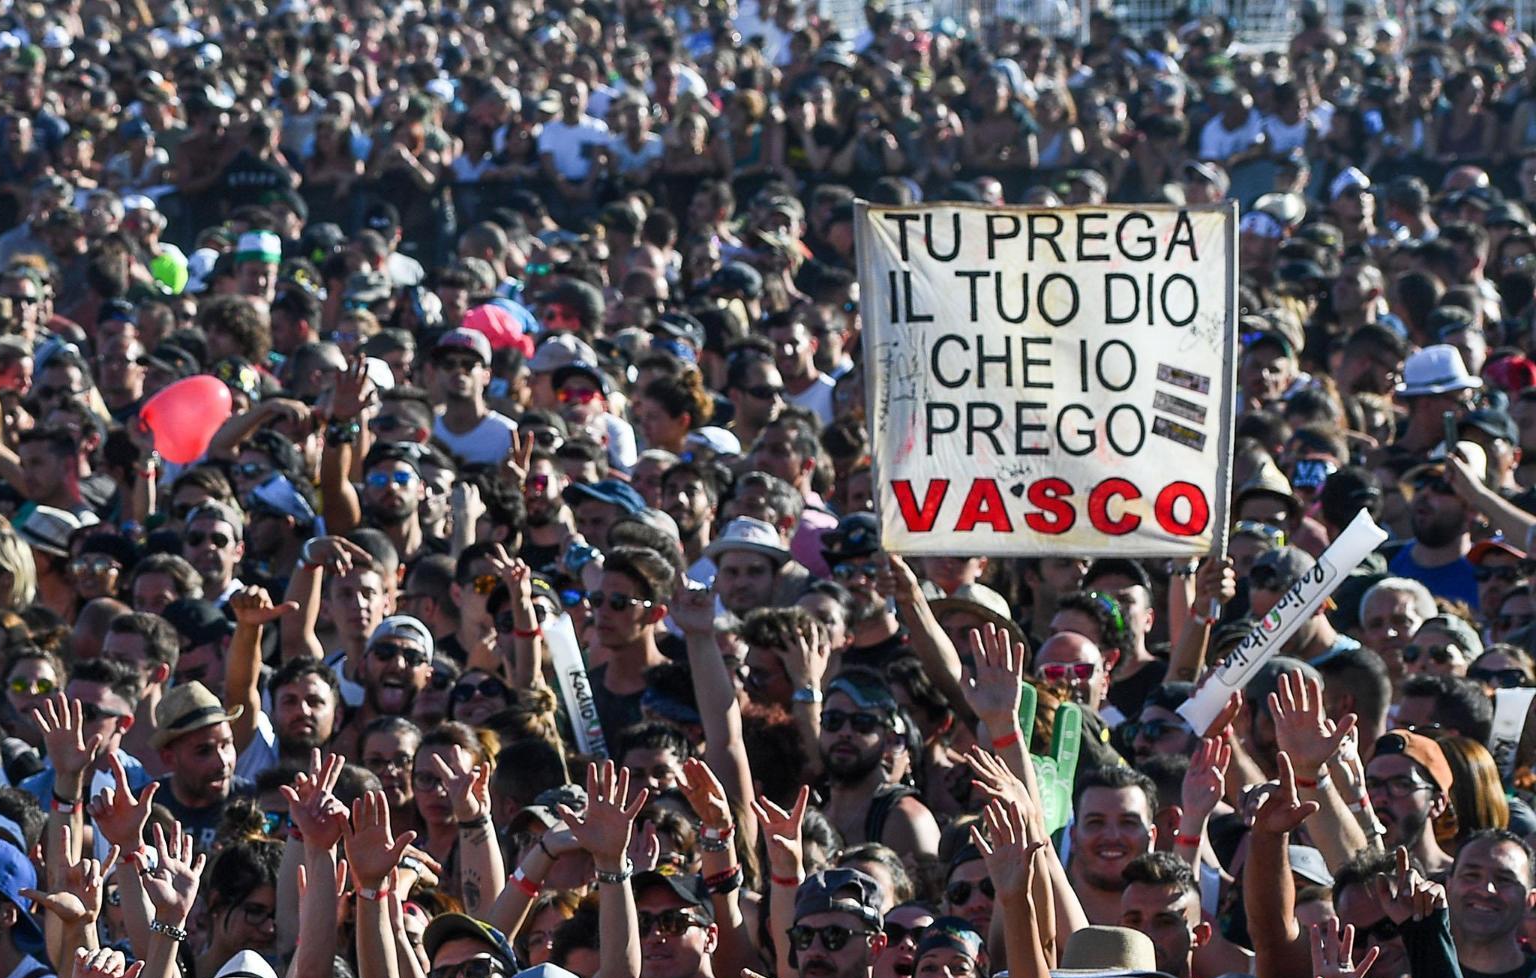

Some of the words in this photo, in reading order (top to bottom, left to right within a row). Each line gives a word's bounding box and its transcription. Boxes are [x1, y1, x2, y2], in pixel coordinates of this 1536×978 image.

[884, 212, 961, 262] TU
[986, 211, 1199, 262] PREGA
[888, 271, 934, 324] IL
[954, 271, 1080, 327] TUO
[1105, 272, 1199, 327] DIO
[931, 334, 1054, 389] CHE
[1080, 339, 1137, 392] IO
[925, 402, 1147, 457] PREGO
[890, 477, 1210, 536] VASCO
